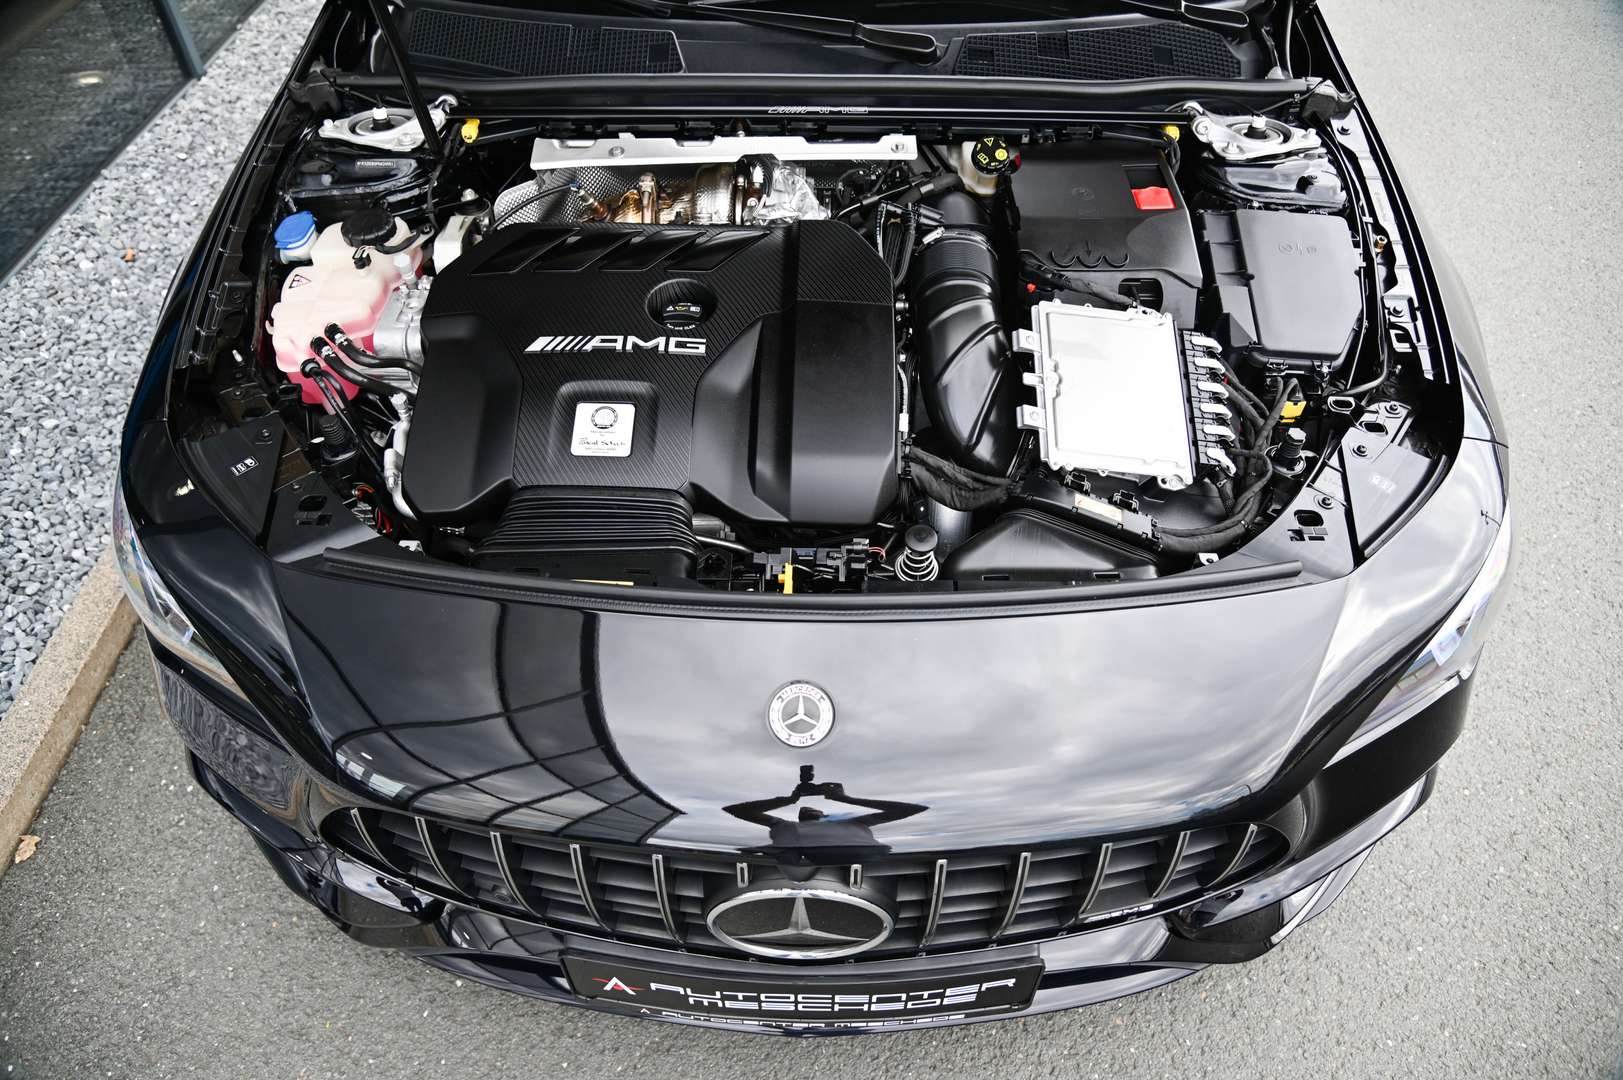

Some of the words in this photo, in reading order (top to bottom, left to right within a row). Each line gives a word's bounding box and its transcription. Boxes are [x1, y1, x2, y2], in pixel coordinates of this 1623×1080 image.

[583, 335, 707, 356] AMG
[650, 977, 1017, 1004] AUTOCENTER
[688, 993, 978, 1012] MESCHEDE
